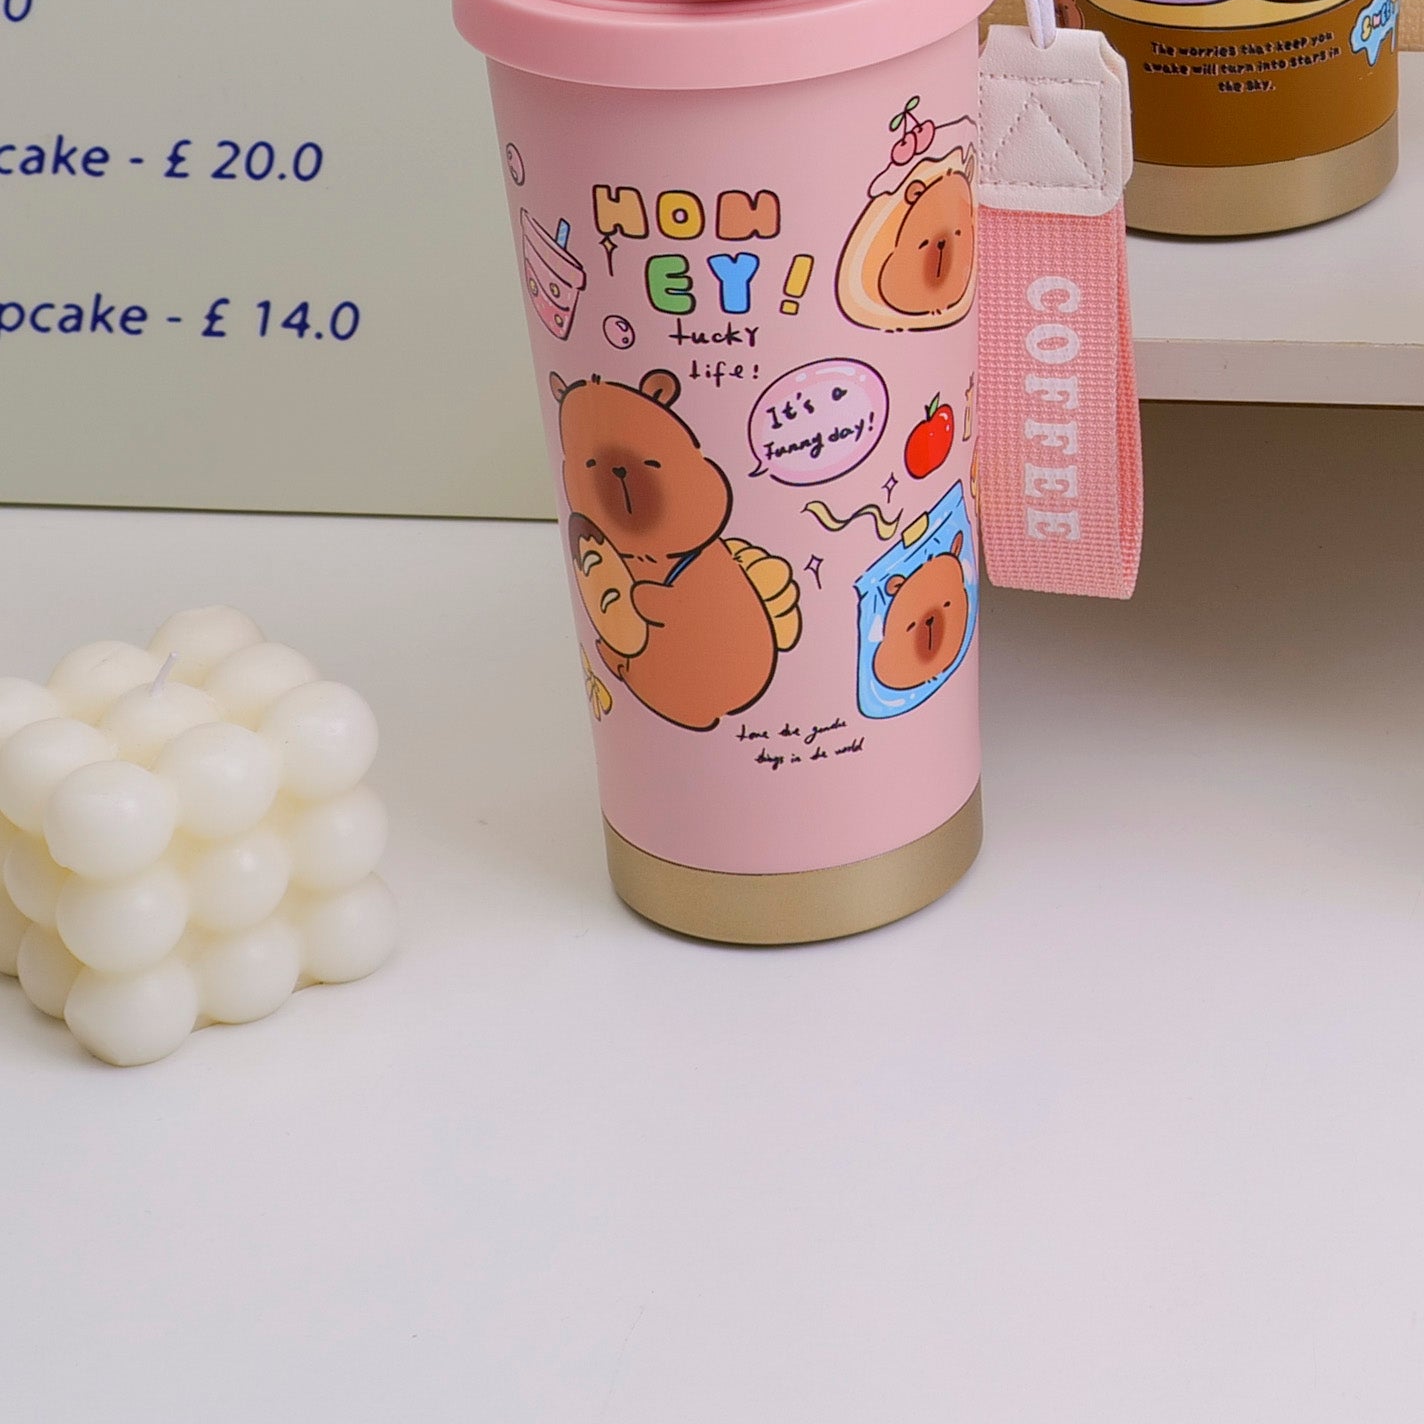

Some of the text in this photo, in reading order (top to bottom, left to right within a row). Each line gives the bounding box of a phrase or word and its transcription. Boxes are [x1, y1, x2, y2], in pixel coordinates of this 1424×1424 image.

[1143, 62, 1190, 76] awake
[1192, 63, 1219, 76] will
[1221, 63, 1256, 74] turn
[1258, 60, 1288, 73] into
[1328, 47, 1341, 59] in
[1151, 32, 1334, 58] The worries that keep you
[1218, 80, 1244, 93] the
[211, 139, 323, 182] 20.0
[645, 251, 815, 316] EY!
[257, 300, 360, 341] 14.0
[766, 387, 848, 429] It's a
[828, 412, 875, 442] day!
[1024, 276, 1081, 542] COFFEE
